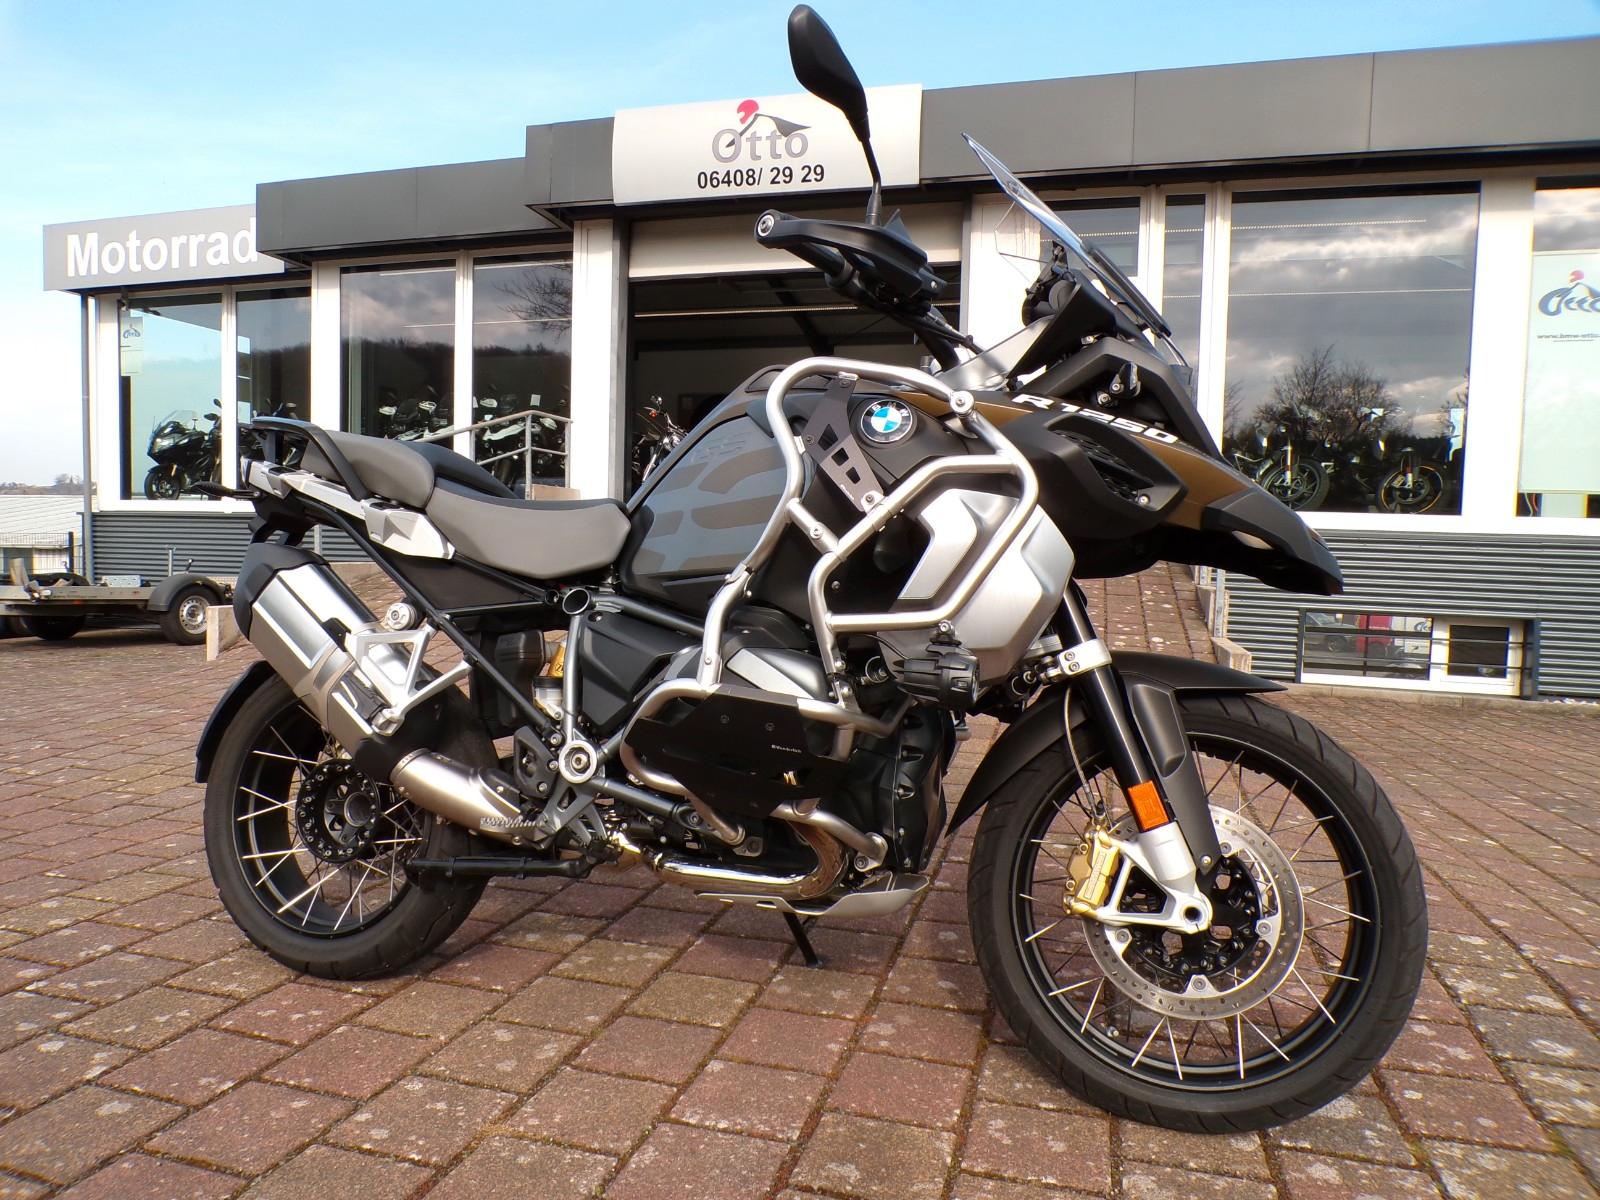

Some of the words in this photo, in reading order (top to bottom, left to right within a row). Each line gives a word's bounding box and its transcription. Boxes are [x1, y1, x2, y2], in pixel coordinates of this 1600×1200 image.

[712, 128, 808, 163] Otto
[697, 167, 763, 189] 06408/
[770, 166, 793, 185] 29
[801, 164, 825, 184] 29
[66, 217, 258, 277] Motorrad
[1012, 393, 1054, 410] R
[1060, 402, 1179, 444] 1250
